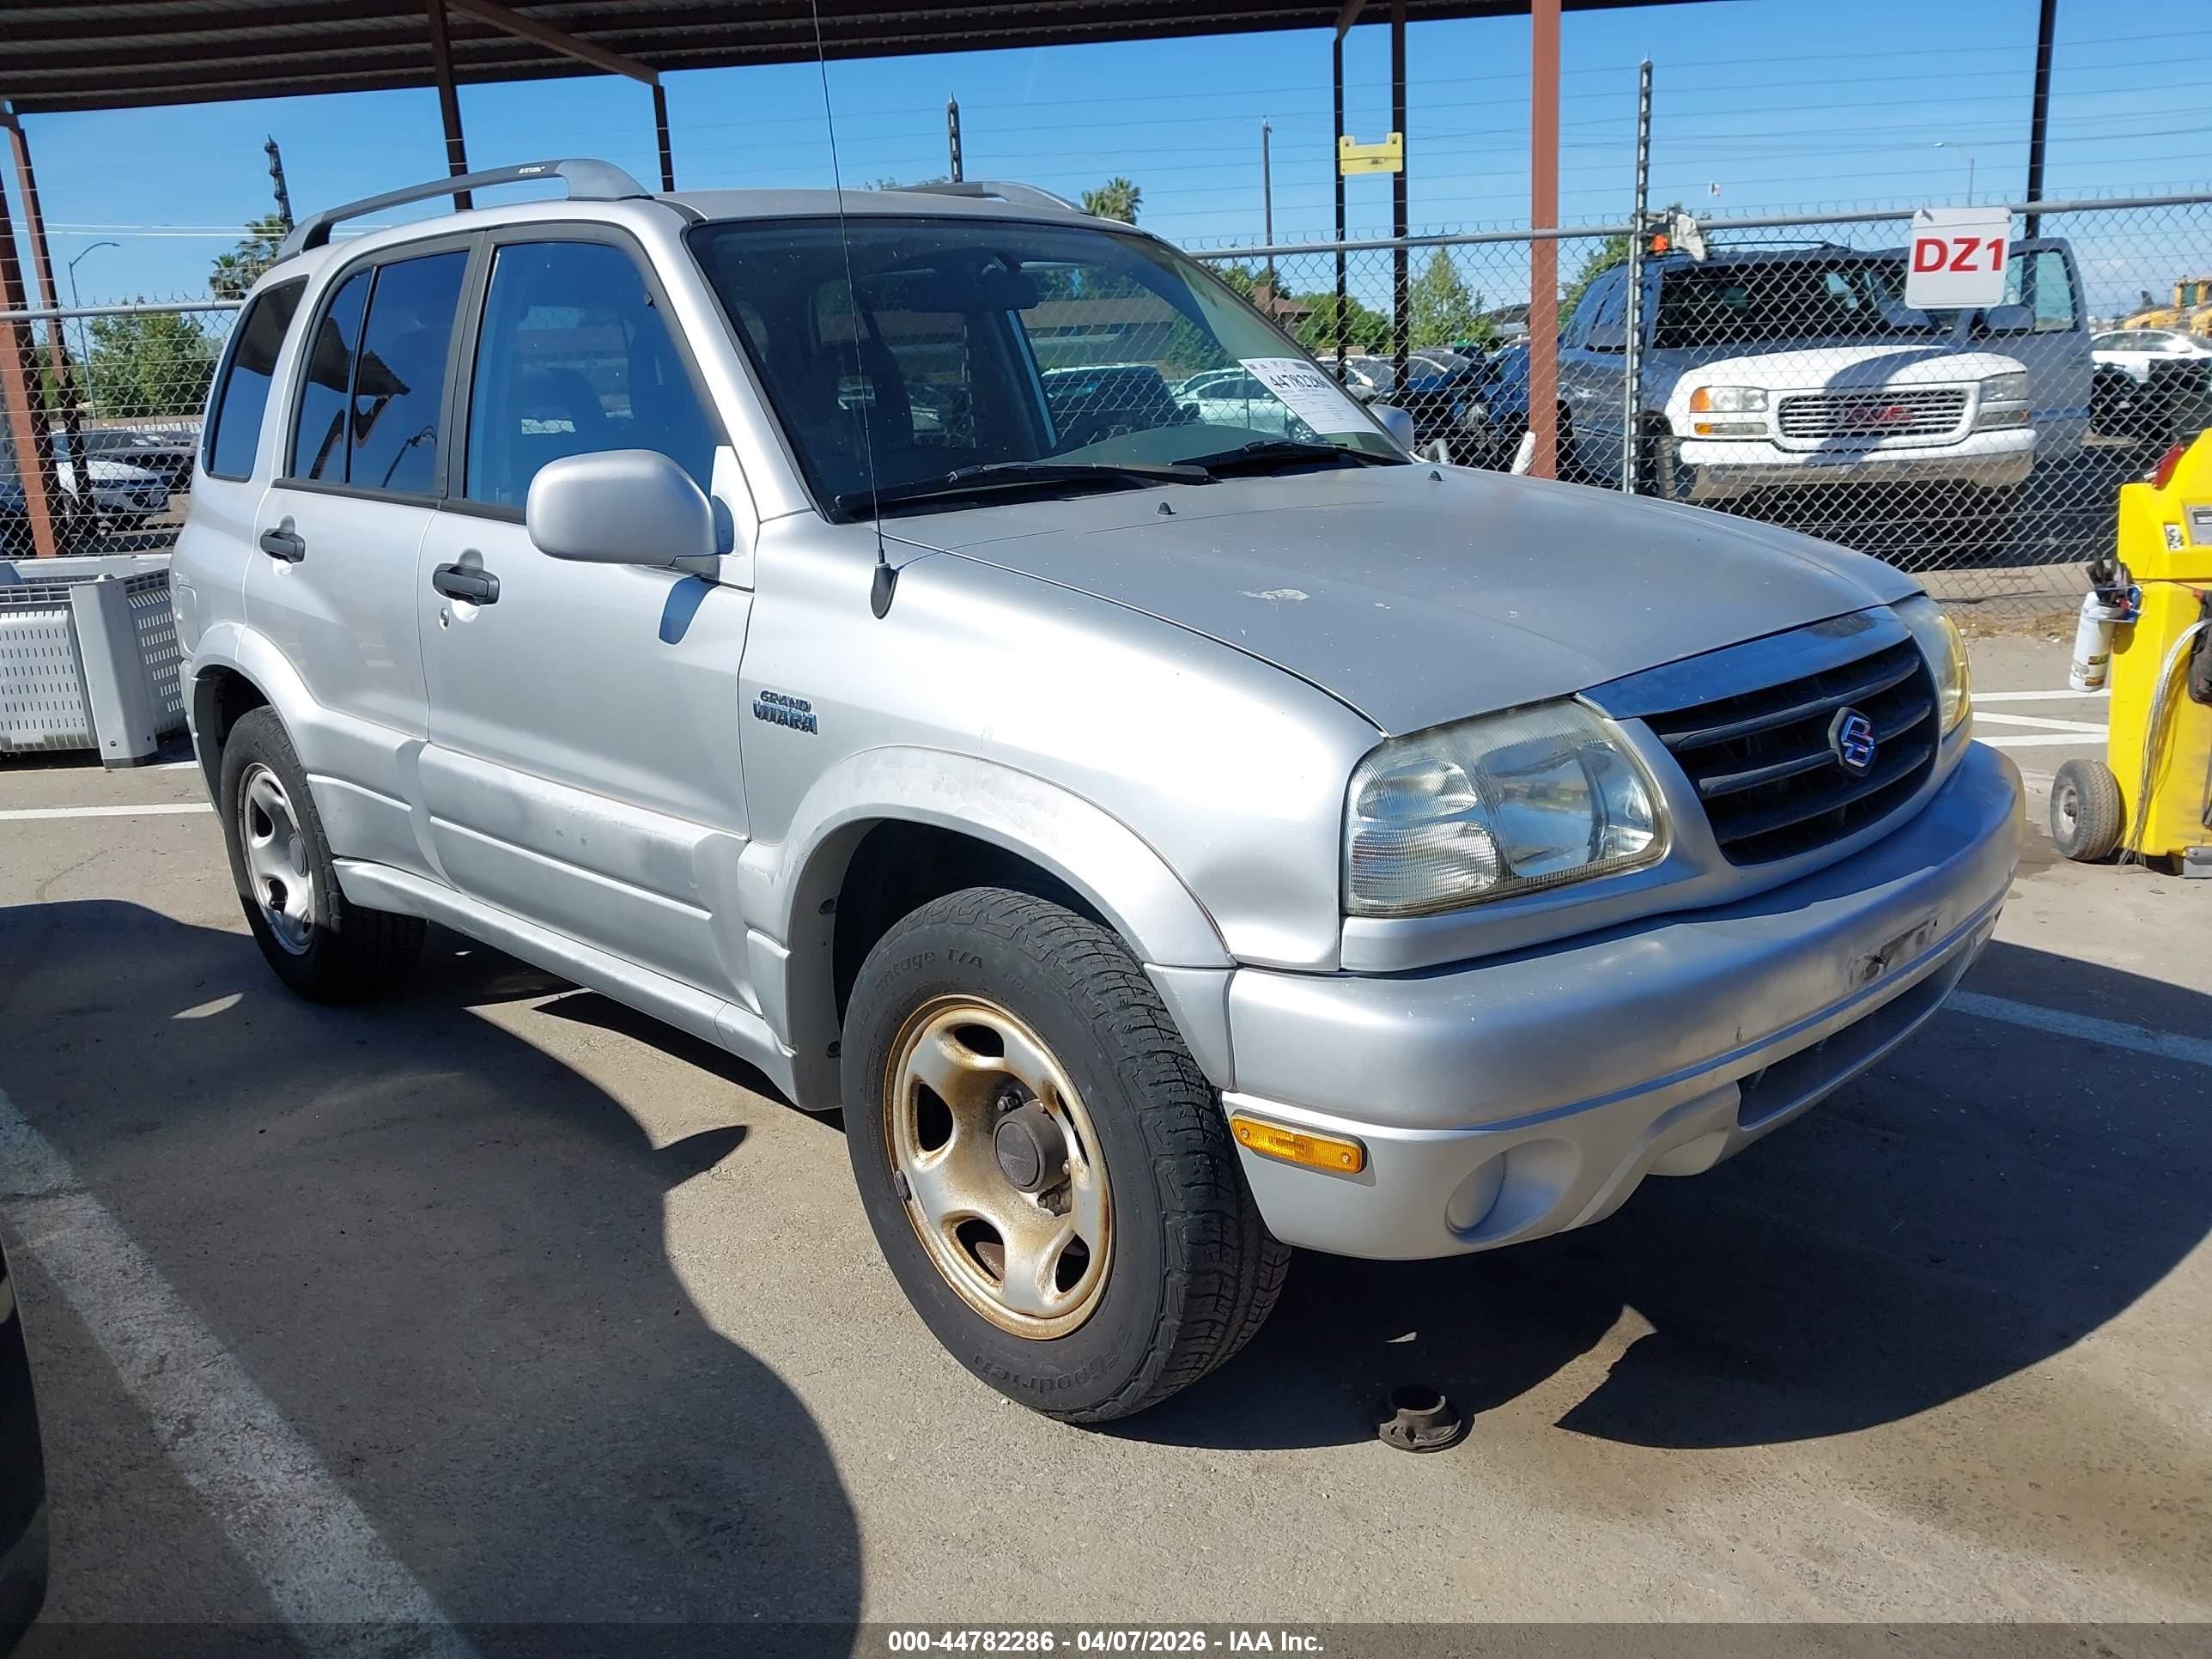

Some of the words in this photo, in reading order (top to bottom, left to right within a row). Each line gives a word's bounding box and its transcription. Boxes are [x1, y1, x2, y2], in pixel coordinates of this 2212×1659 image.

[1913, 237, 2004, 273] DZ1
[752, 699, 818, 736] VITARA
[760, 690, 811, 714] GRAND
